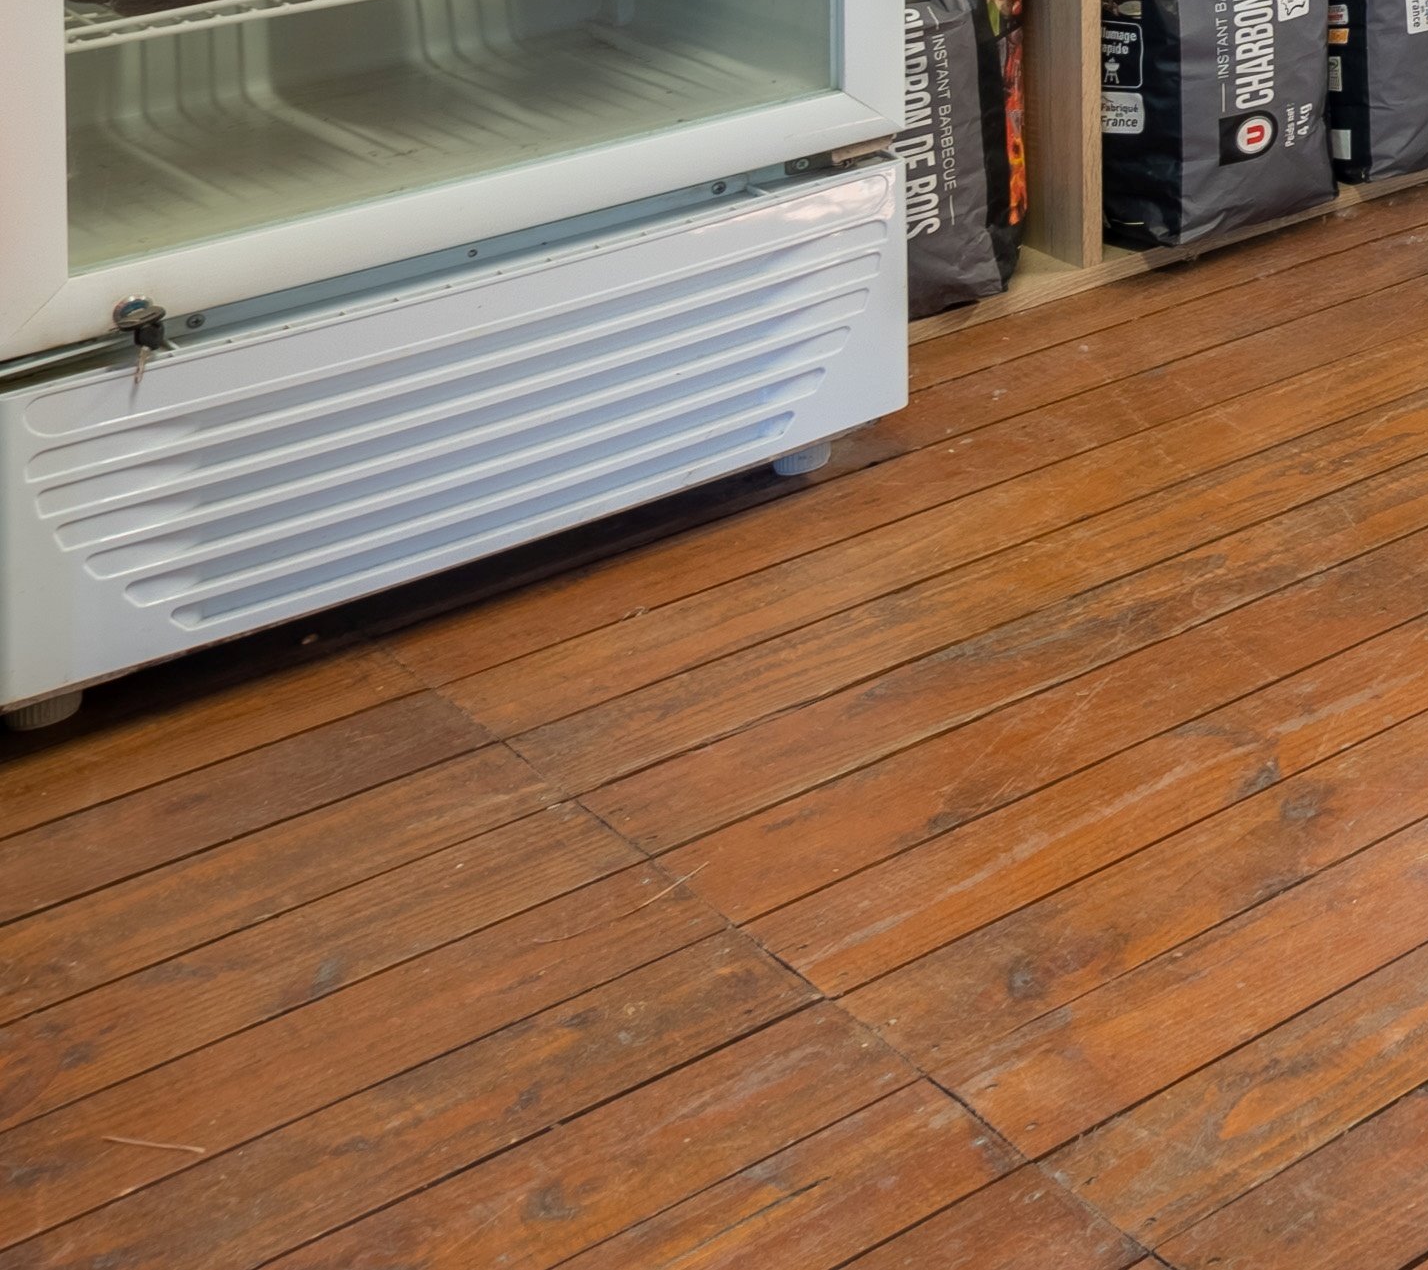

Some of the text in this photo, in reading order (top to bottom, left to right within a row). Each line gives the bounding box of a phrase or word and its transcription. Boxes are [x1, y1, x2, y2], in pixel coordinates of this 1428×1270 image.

[1216, 16, 1230, 79] INSTANT
[934, 33, 958, 193] INSTANT BARBECUE
[1296, 102, 1313, 137] 4 kg
[908, 163, 941, 241] BOIS
